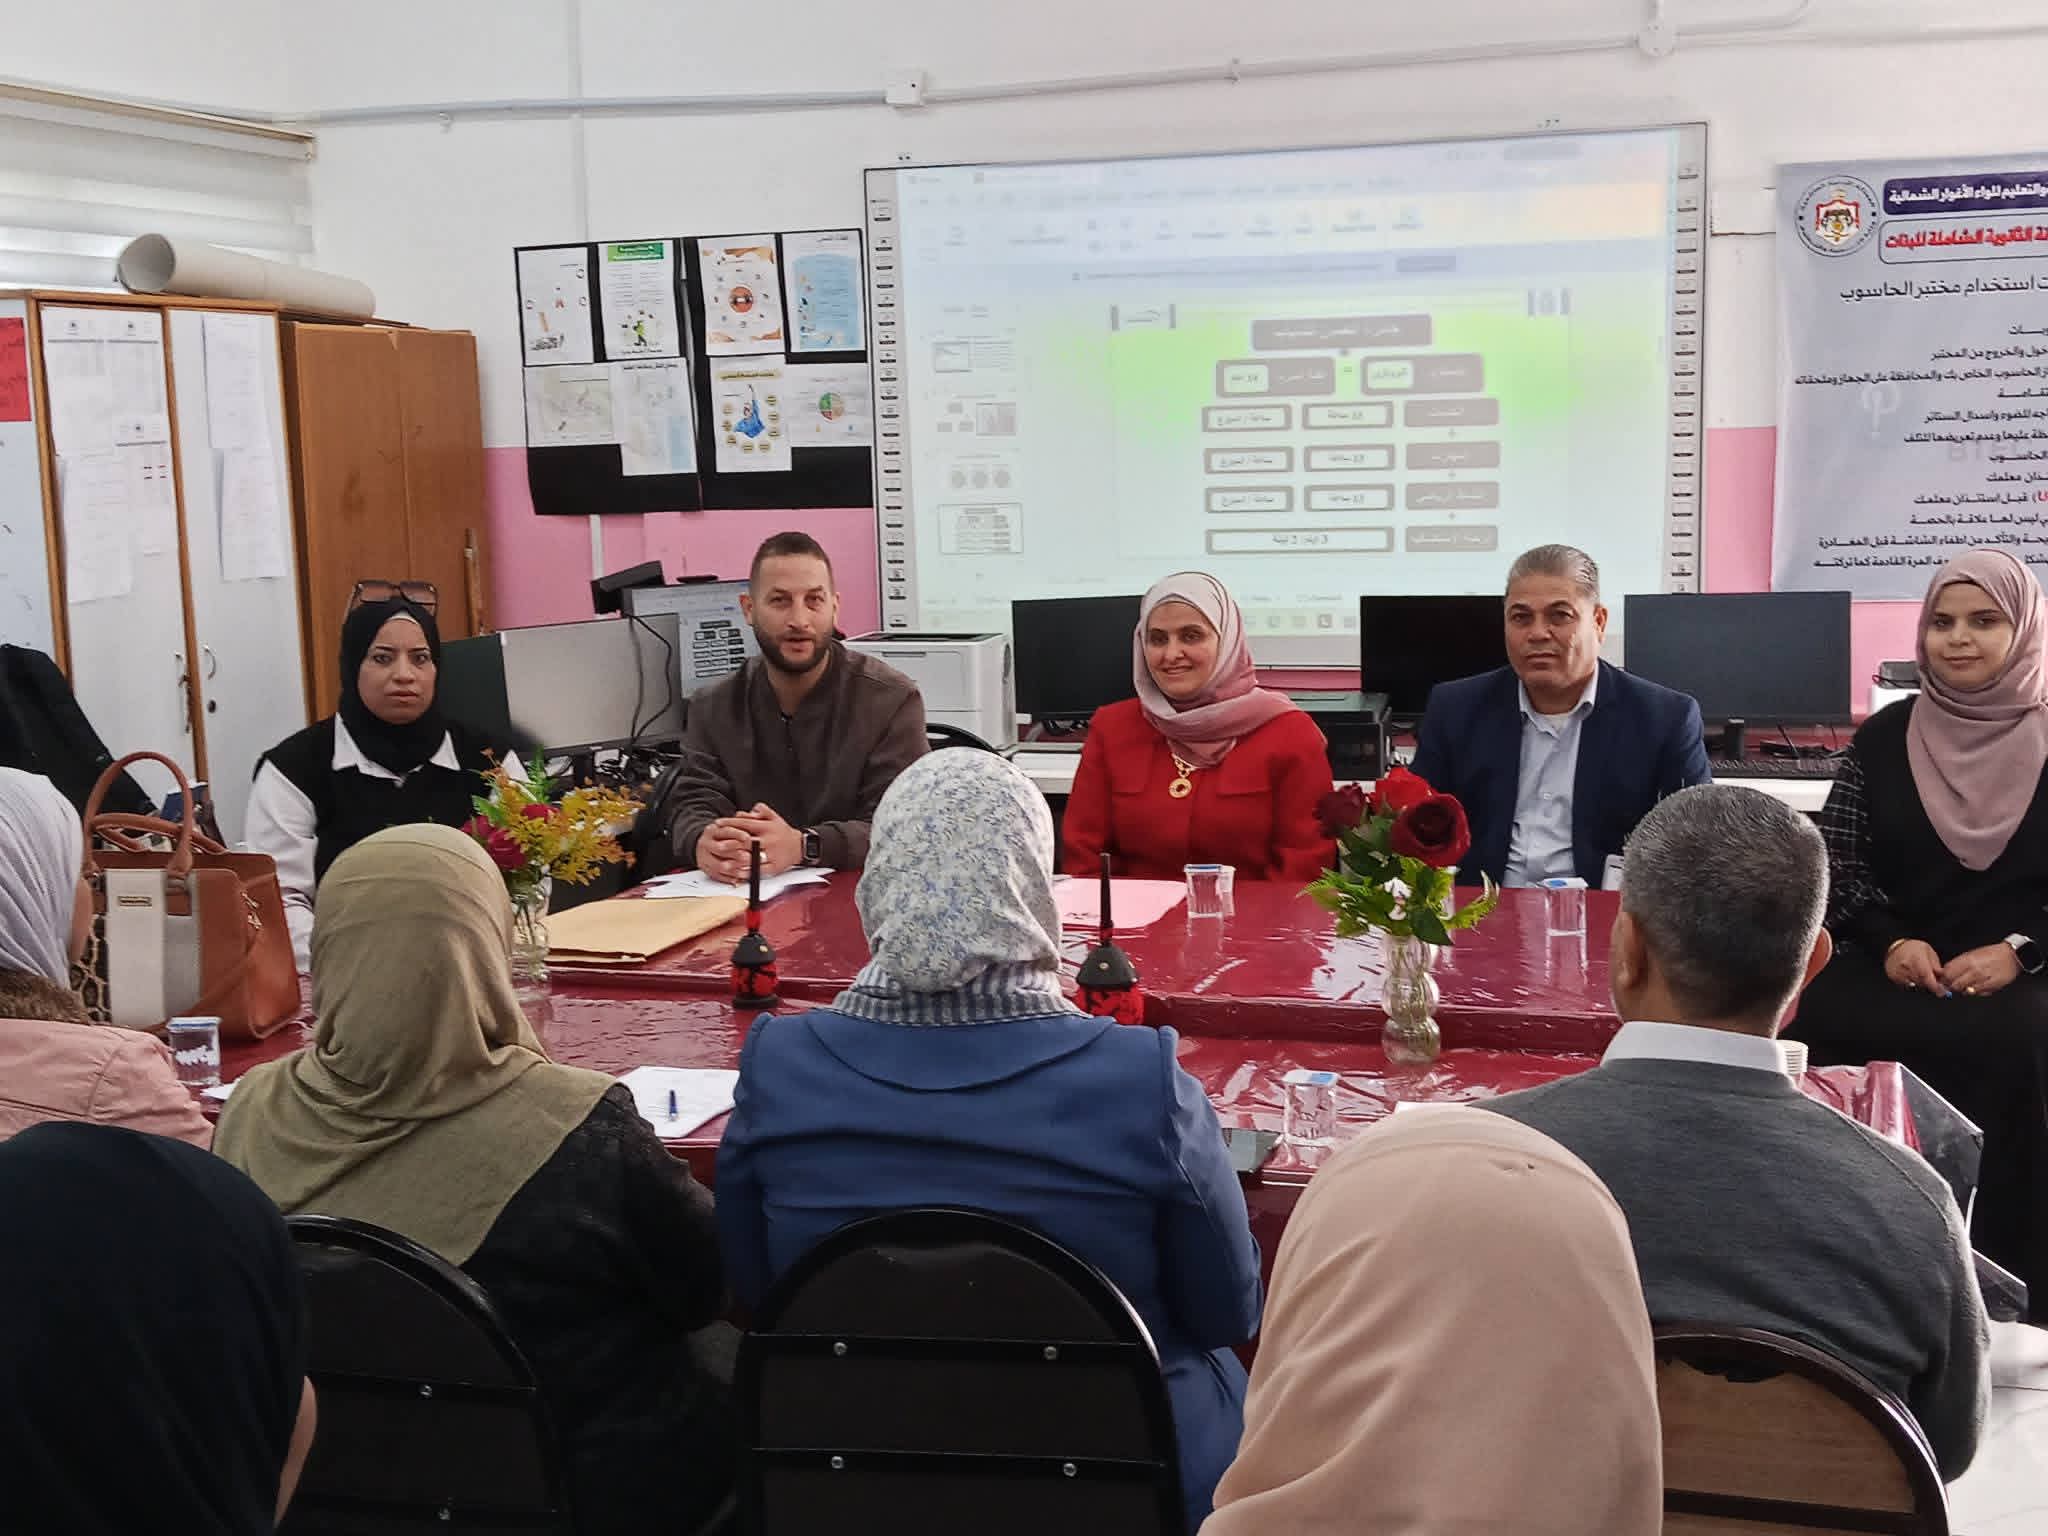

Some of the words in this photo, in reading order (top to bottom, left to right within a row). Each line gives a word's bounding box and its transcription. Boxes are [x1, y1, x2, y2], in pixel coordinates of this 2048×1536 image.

[1889, 187, 1940, 205] الشمالية
[1885, 229, 1927, 251] للبنات
[1927, 228, 1985, 246] الشاملة
[1840, 280, 1913, 303] الحاسوب
[1913, 279, 1962, 299] مختبر
[1964, 275, 2035, 298] استخدام
